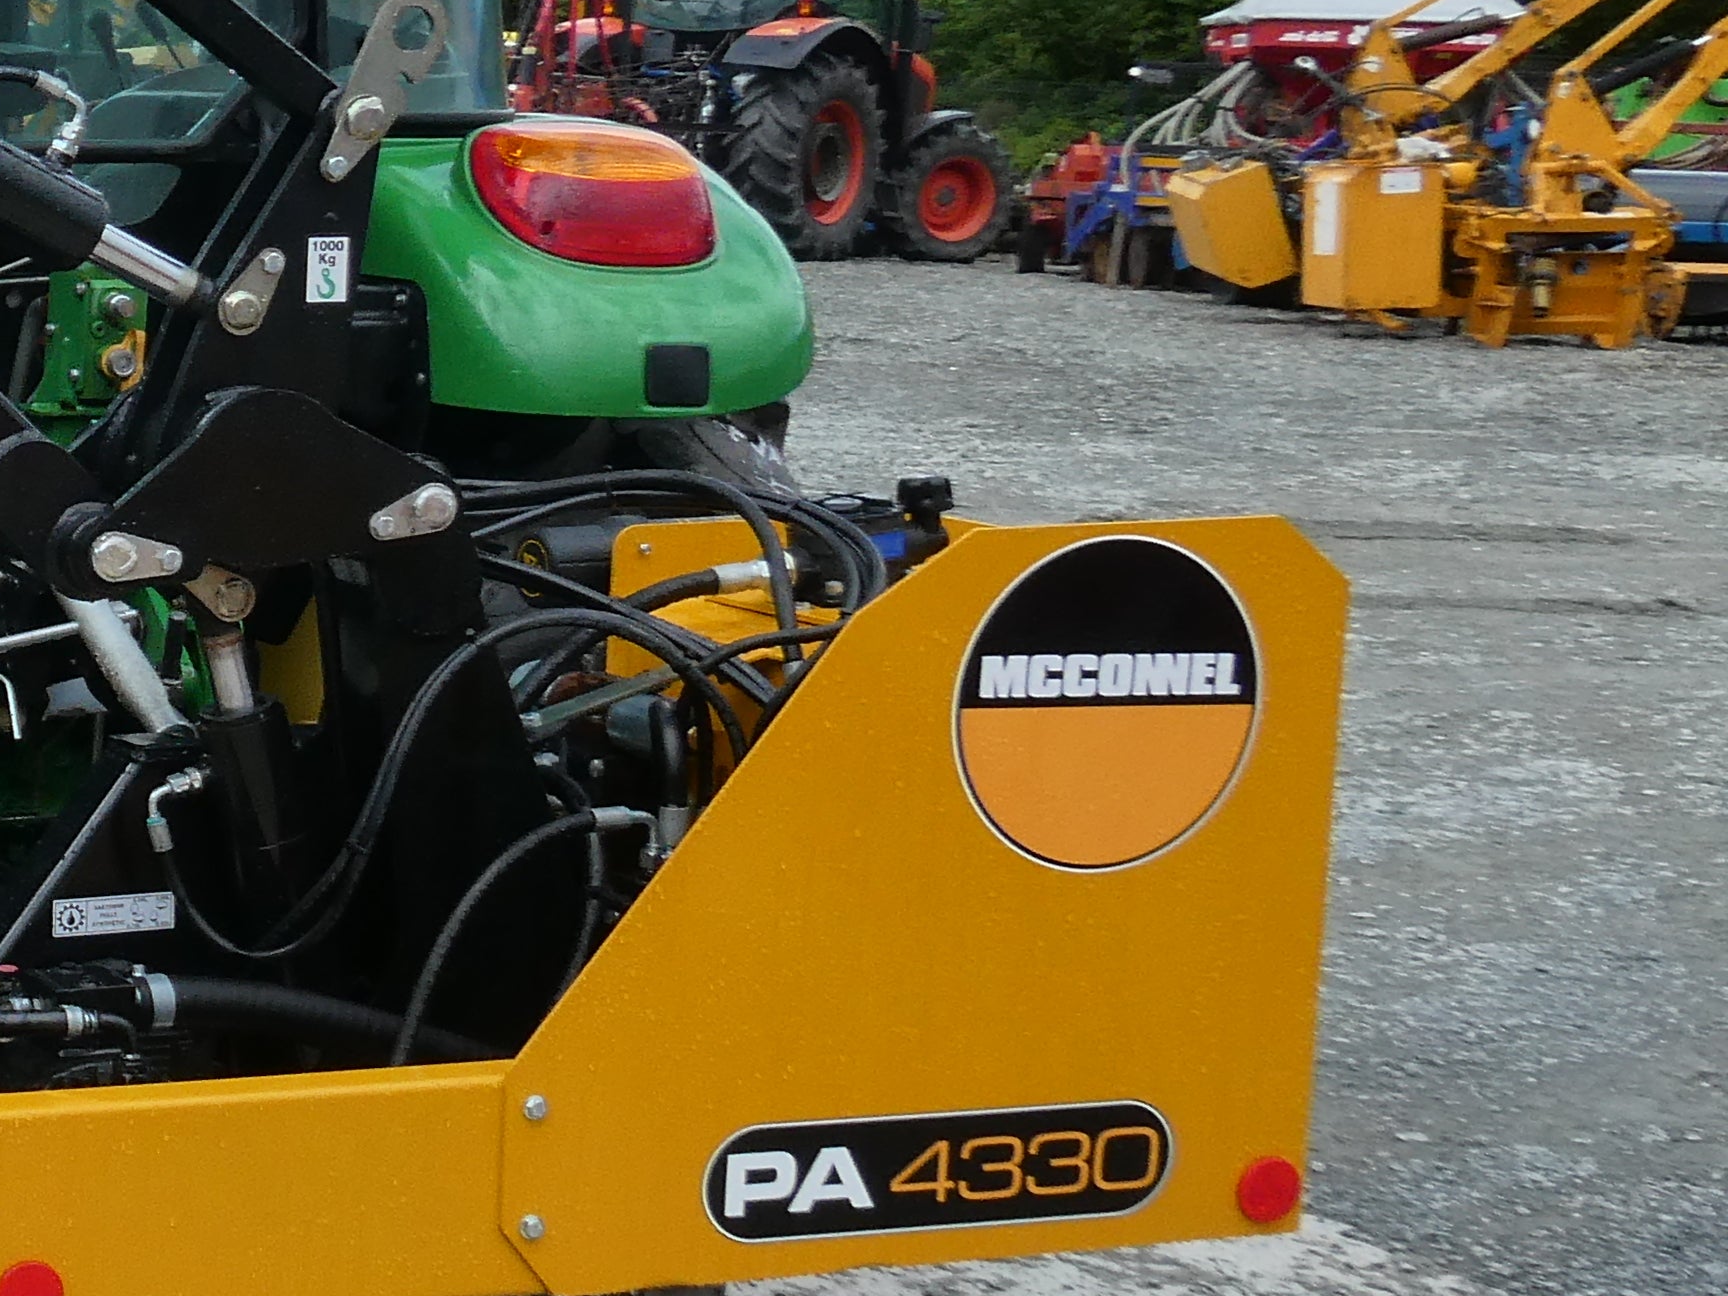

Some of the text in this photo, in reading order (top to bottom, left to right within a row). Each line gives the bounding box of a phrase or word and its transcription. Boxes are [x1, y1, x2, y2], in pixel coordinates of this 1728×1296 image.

[312, 240, 344, 252] 1000
[318, 253, 336, 267] Kg
[979, 653, 1242, 698] MCCONNEL
[723, 1125, 1161, 1219] PA 4330
